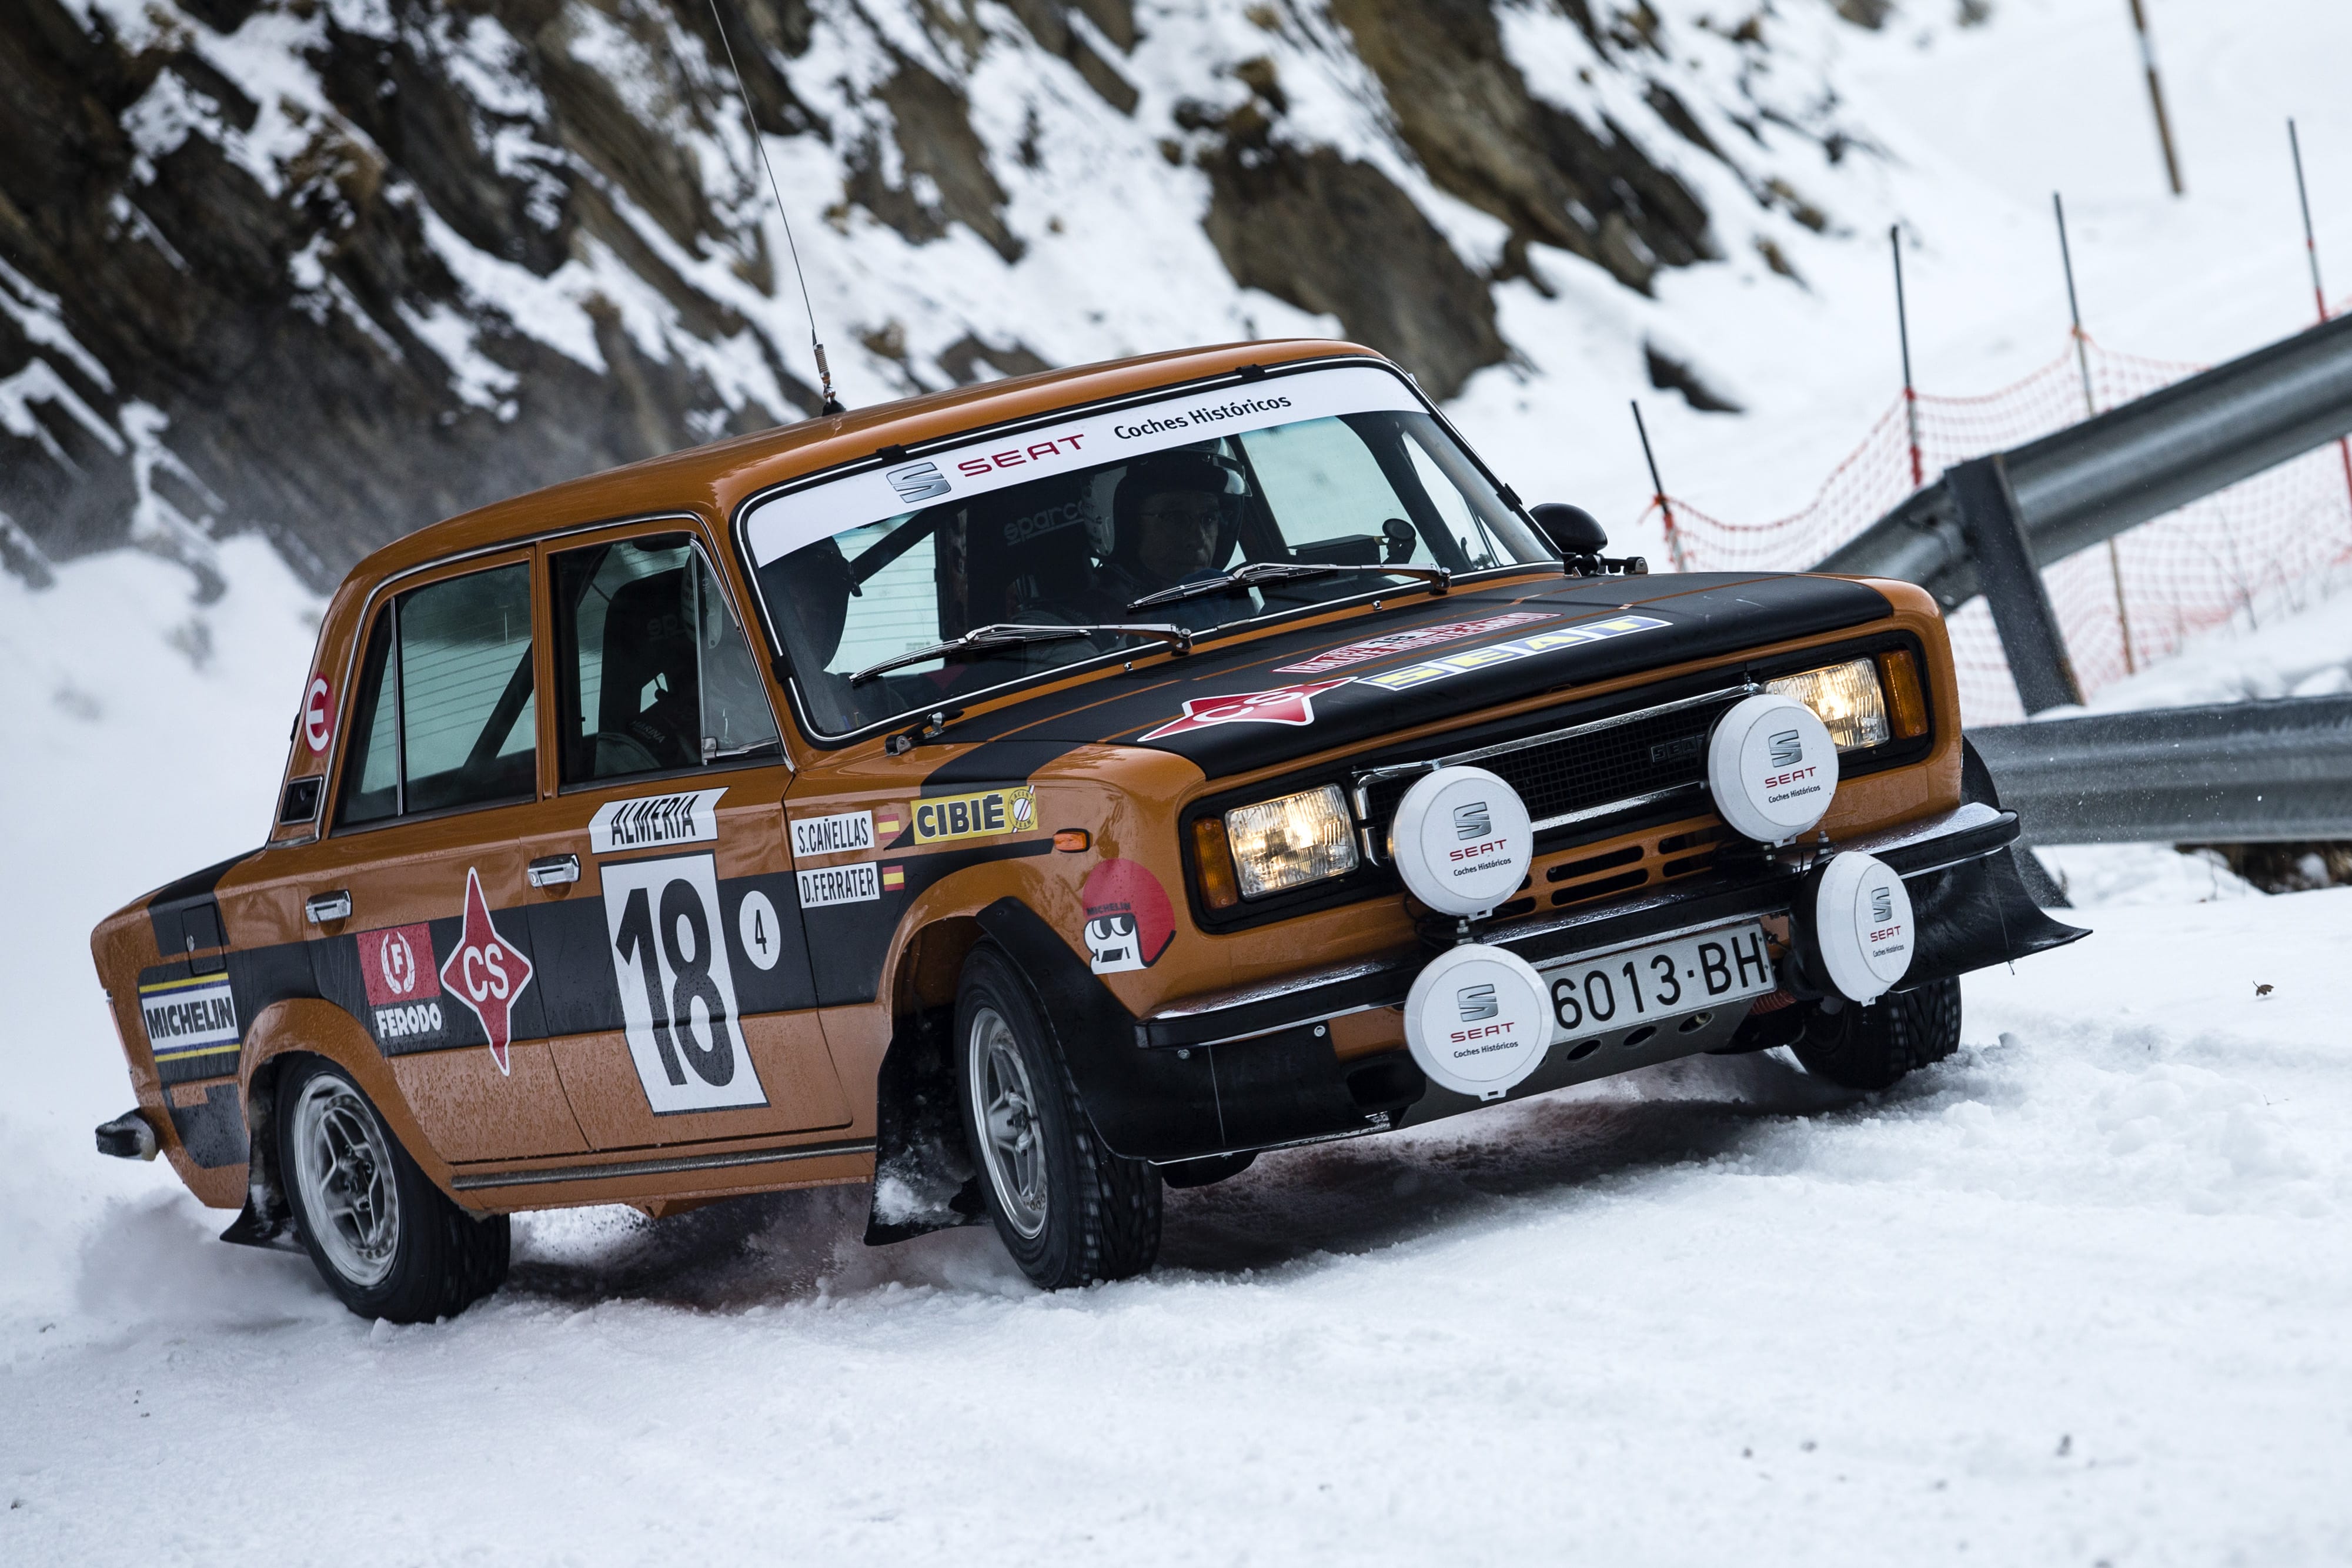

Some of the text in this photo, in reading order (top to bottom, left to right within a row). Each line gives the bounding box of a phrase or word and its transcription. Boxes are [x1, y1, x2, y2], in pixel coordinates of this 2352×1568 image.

[958, 394, 1292, 477] SEAT Coches Históricos
[1004, 500, 1084, 543] sparc
[1285, 613, 1548, 670] RALLYE MONTE-CARLO
[1368, 636, 1416, 645] 18
[1372, 617, 1664, 686] SEAT
[1193, 689, 1305, 723] CS
[1765, 767, 1816, 788] SEAT
[1769, 785, 1821, 803] Coches Históricos
[610, 794, 699, 845] ALMERIA
[917, 794, 1004, 839] CIBIÉ
[797, 817, 868, 854] S.CAÑELLAS
[1449, 839, 1506, 861] SEAT
[801, 862, 875, 904] D.FERRATER
[1454, 858, 1512, 876] Coches Históricos
[1086, 901, 1131, 916] MICHELIN
[754, 910, 767, 954] 4
[1870, 925, 1901, 942] SEAT
[390, 944, 403, 974] F
[463, 944, 509, 1002] CS
[616, 878, 734, 1087] 18
[145, 996, 235, 1039] MICHELIN
[375, 1003, 441, 1038] FERODO
[1451, 1022, 1515, 1043] SEAT
[1454, 1041, 1519, 1058] Coches Históricos
